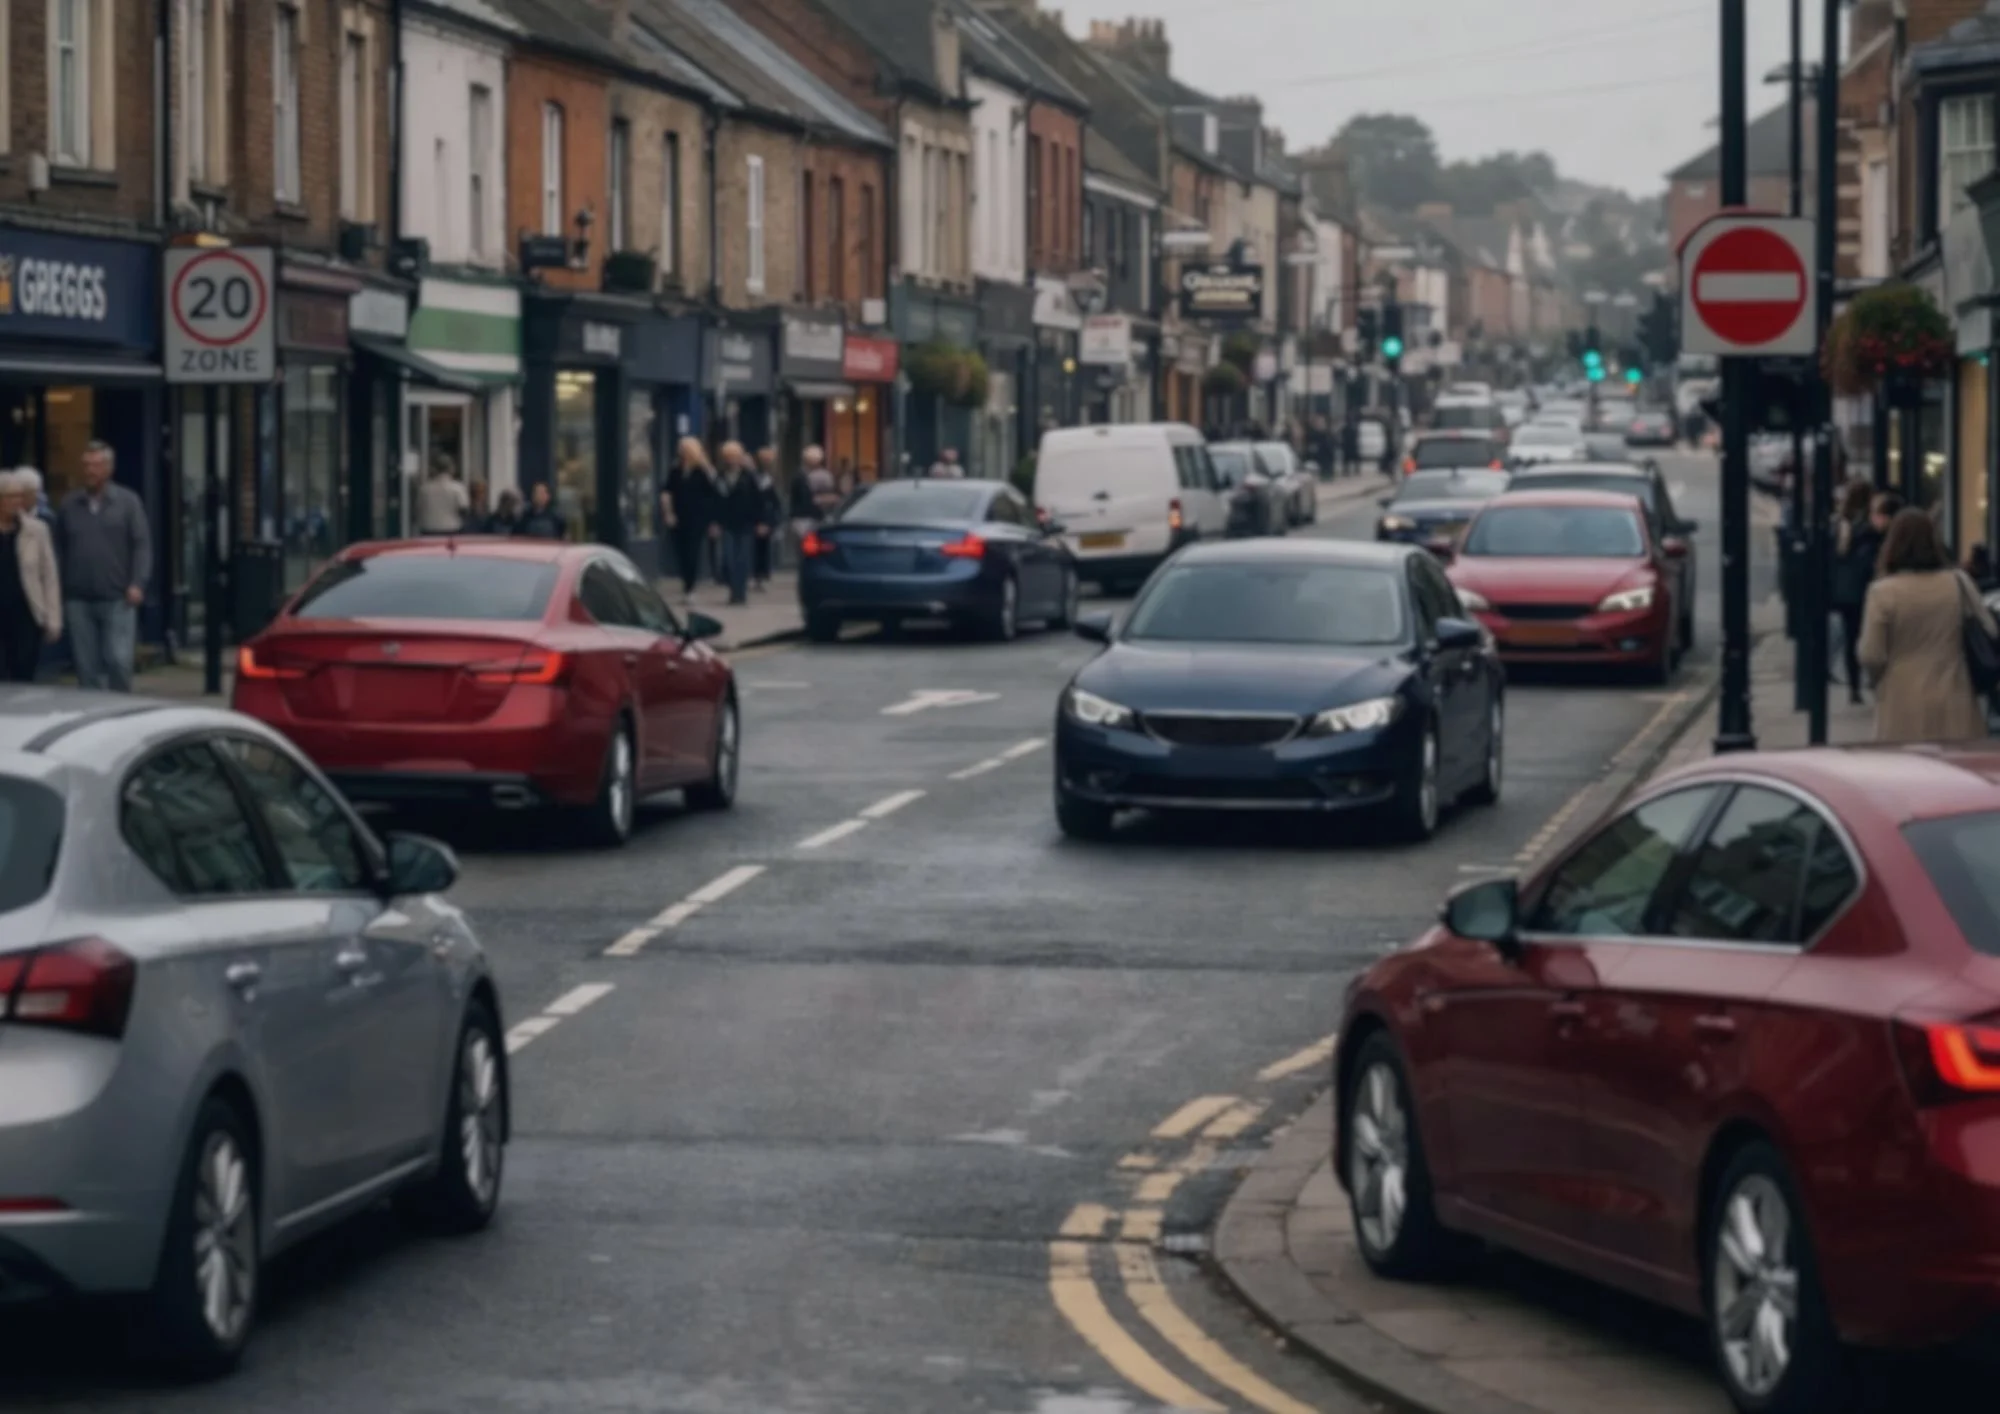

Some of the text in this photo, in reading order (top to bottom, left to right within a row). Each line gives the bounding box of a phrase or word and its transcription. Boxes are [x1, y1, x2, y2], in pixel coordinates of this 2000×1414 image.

[19, 257, 107, 320] GREGGS
[189, 276, 251, 319] 20
[181, 349, 259, 373] ZONE
